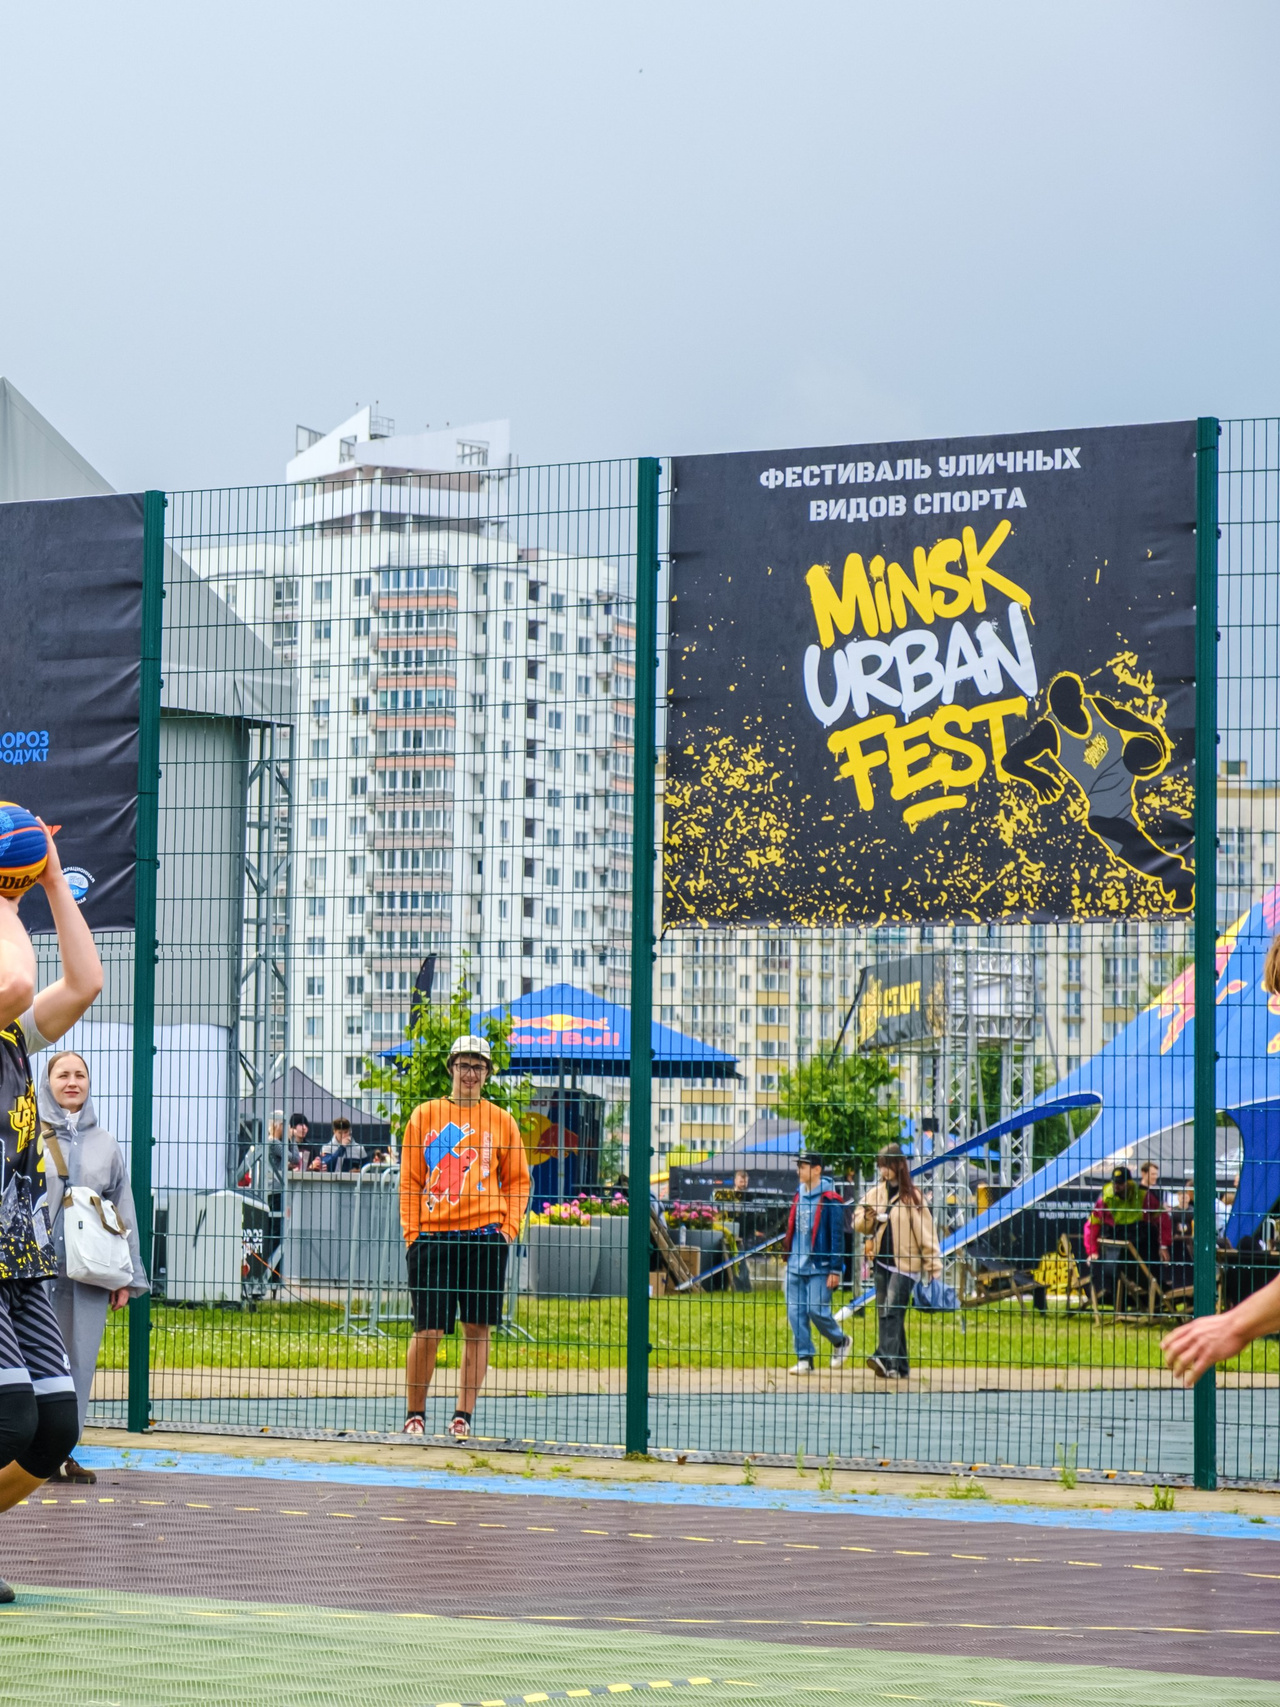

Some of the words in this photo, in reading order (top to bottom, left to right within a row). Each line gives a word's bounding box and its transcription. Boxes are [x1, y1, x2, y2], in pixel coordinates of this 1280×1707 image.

[759, 457, 932, 489] ФЕСТИВАЛЬ
[938, 447, 1082, 478] УЛИЧНЫХ
[809, 495, 907, 523] ВИДОВ
[914, 487, 1027, 515] СПОРТА
[804, 602, 1039, 727] URBAN
[828, 696, 1028, 812] FEST
